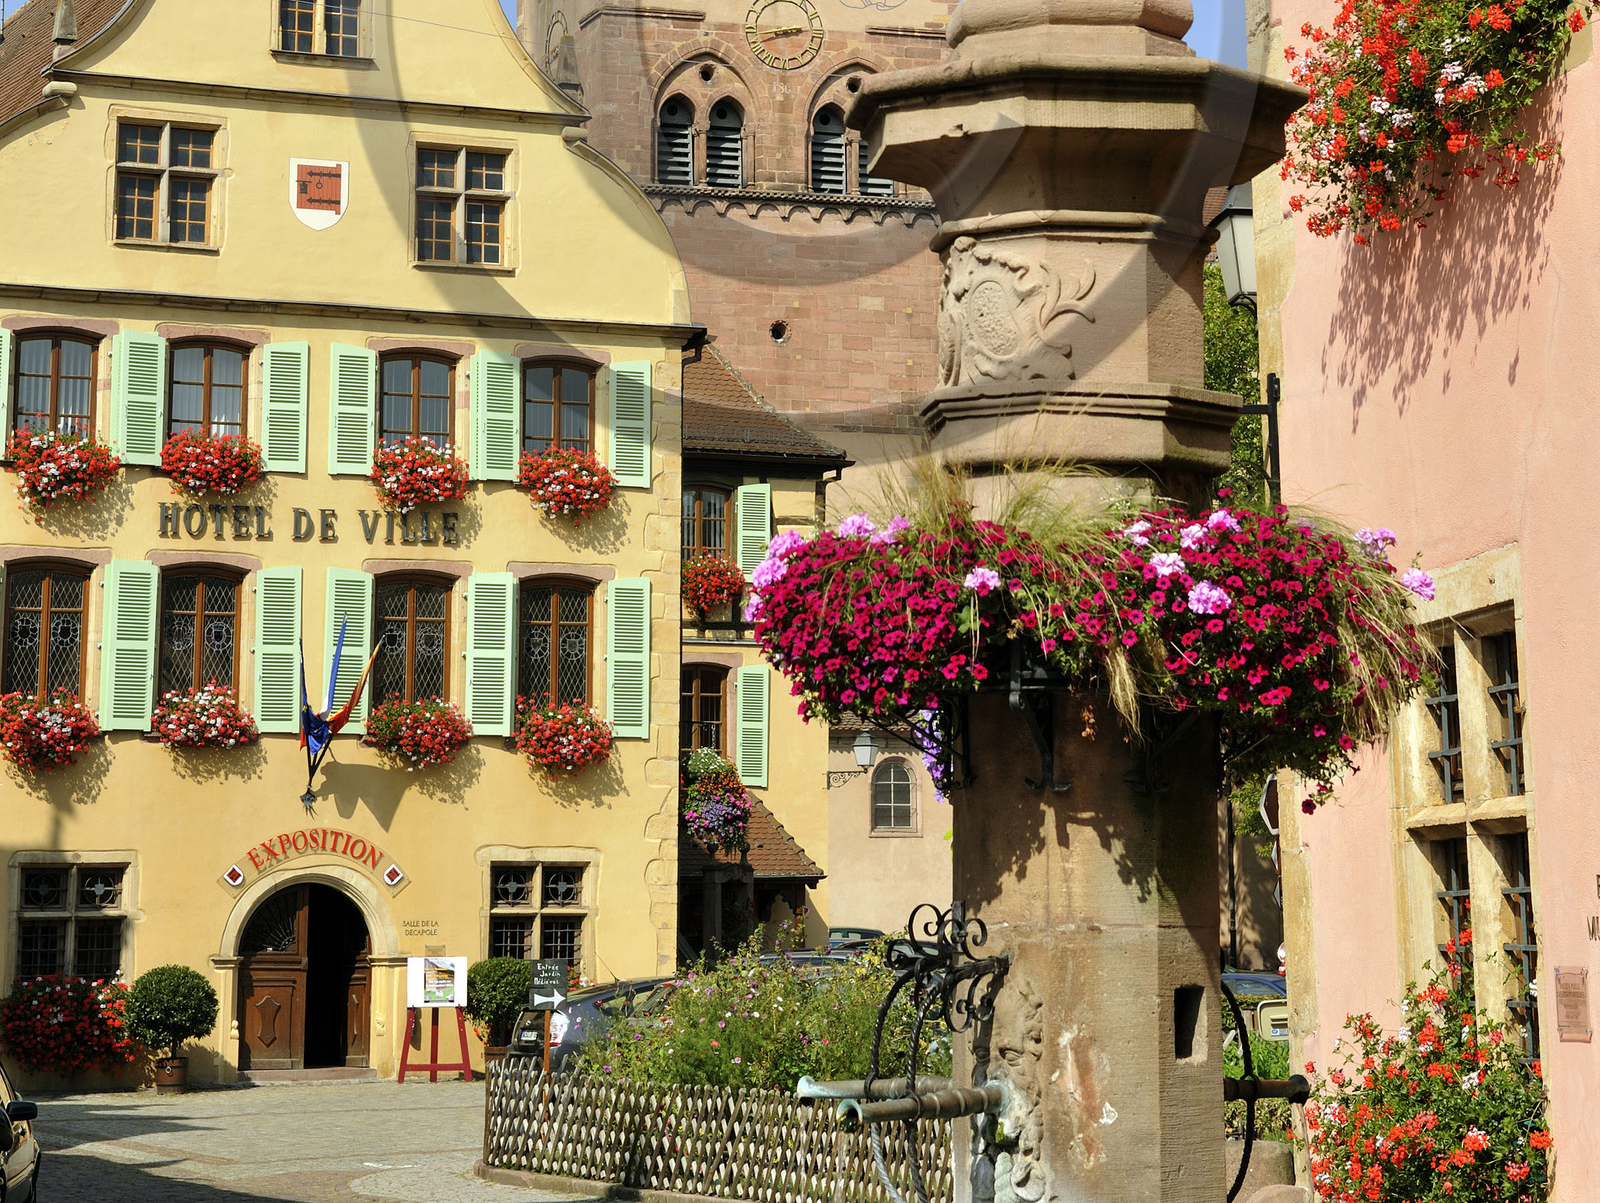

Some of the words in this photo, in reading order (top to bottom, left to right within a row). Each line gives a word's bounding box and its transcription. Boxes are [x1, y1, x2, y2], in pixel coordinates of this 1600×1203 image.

[157, 501, 272, 538] HOTEL
[292, 507, 338, 541] DE
[357, 509, 459, 544] VILLE
[246, 828, 384, 871] EXPOSITION
[539, 970, 561, 978] Jardin
